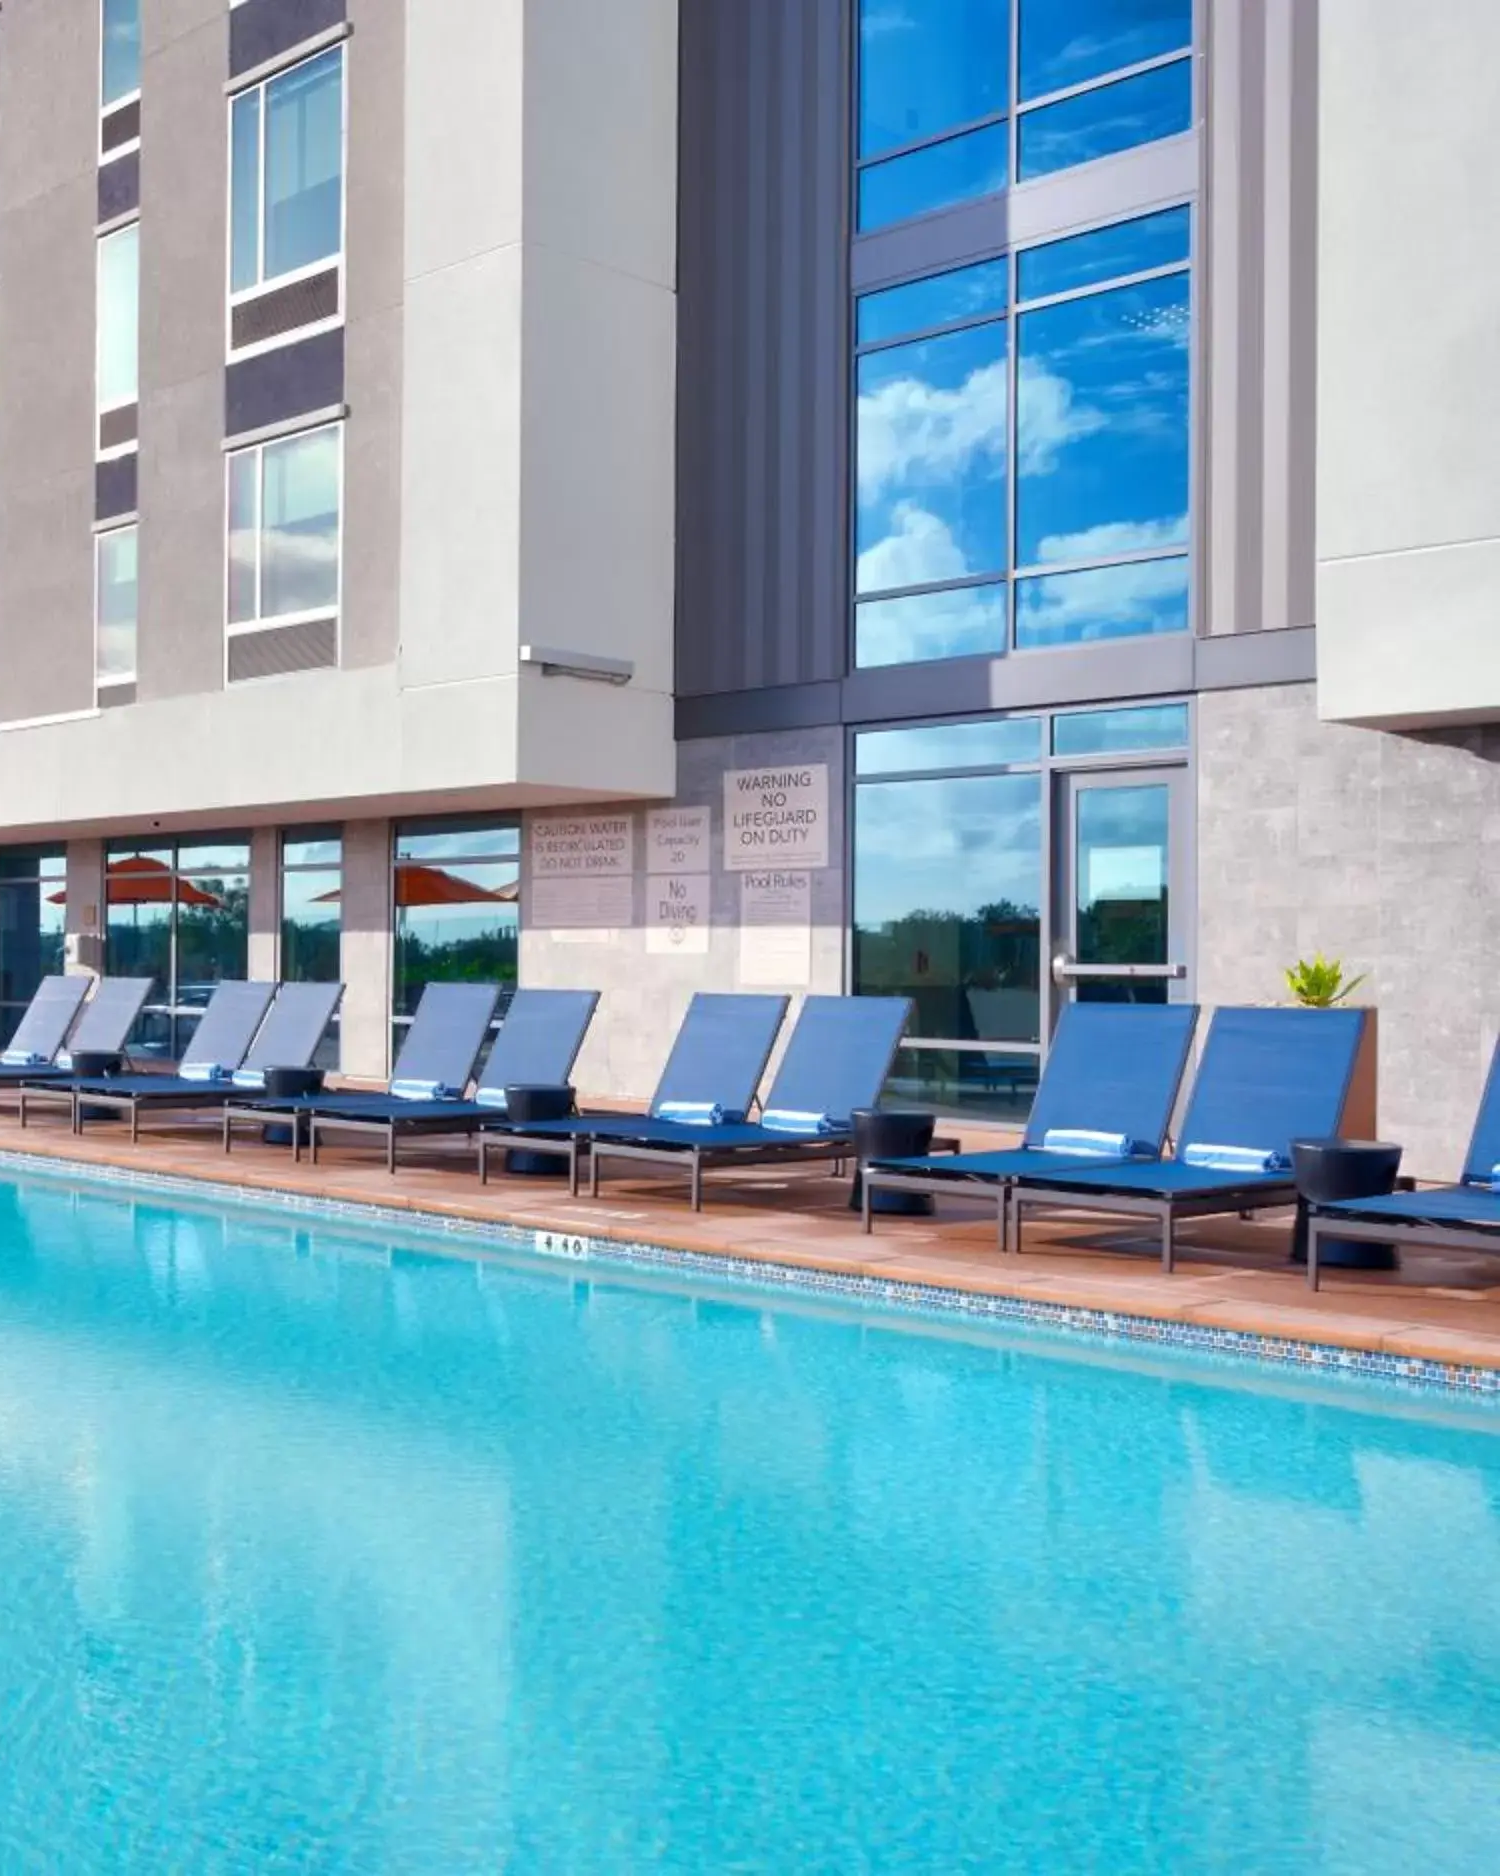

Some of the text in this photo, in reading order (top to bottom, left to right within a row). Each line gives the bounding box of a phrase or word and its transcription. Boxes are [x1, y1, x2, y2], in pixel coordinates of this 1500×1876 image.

[737, 771, 811, 791] WARNING
[761, 792, 787, 808] NO
[653, 814, 678, 829] Pool
[733, 809, 817, 828] LIFEGUARD
[589, 821, 627, 834] WATER
[657, 833, 701, 849] Capacity
[740, 828, 809, 845] ON DUTY
[546, 838, 625, 853] RECIRCULATED
[539, 856, 620, 870] DO NOT DRINK
[745, 872, 808, 889] Pool Rules
[669, 880, 687, 899] No
[659, 900, 698, 925] Diving
